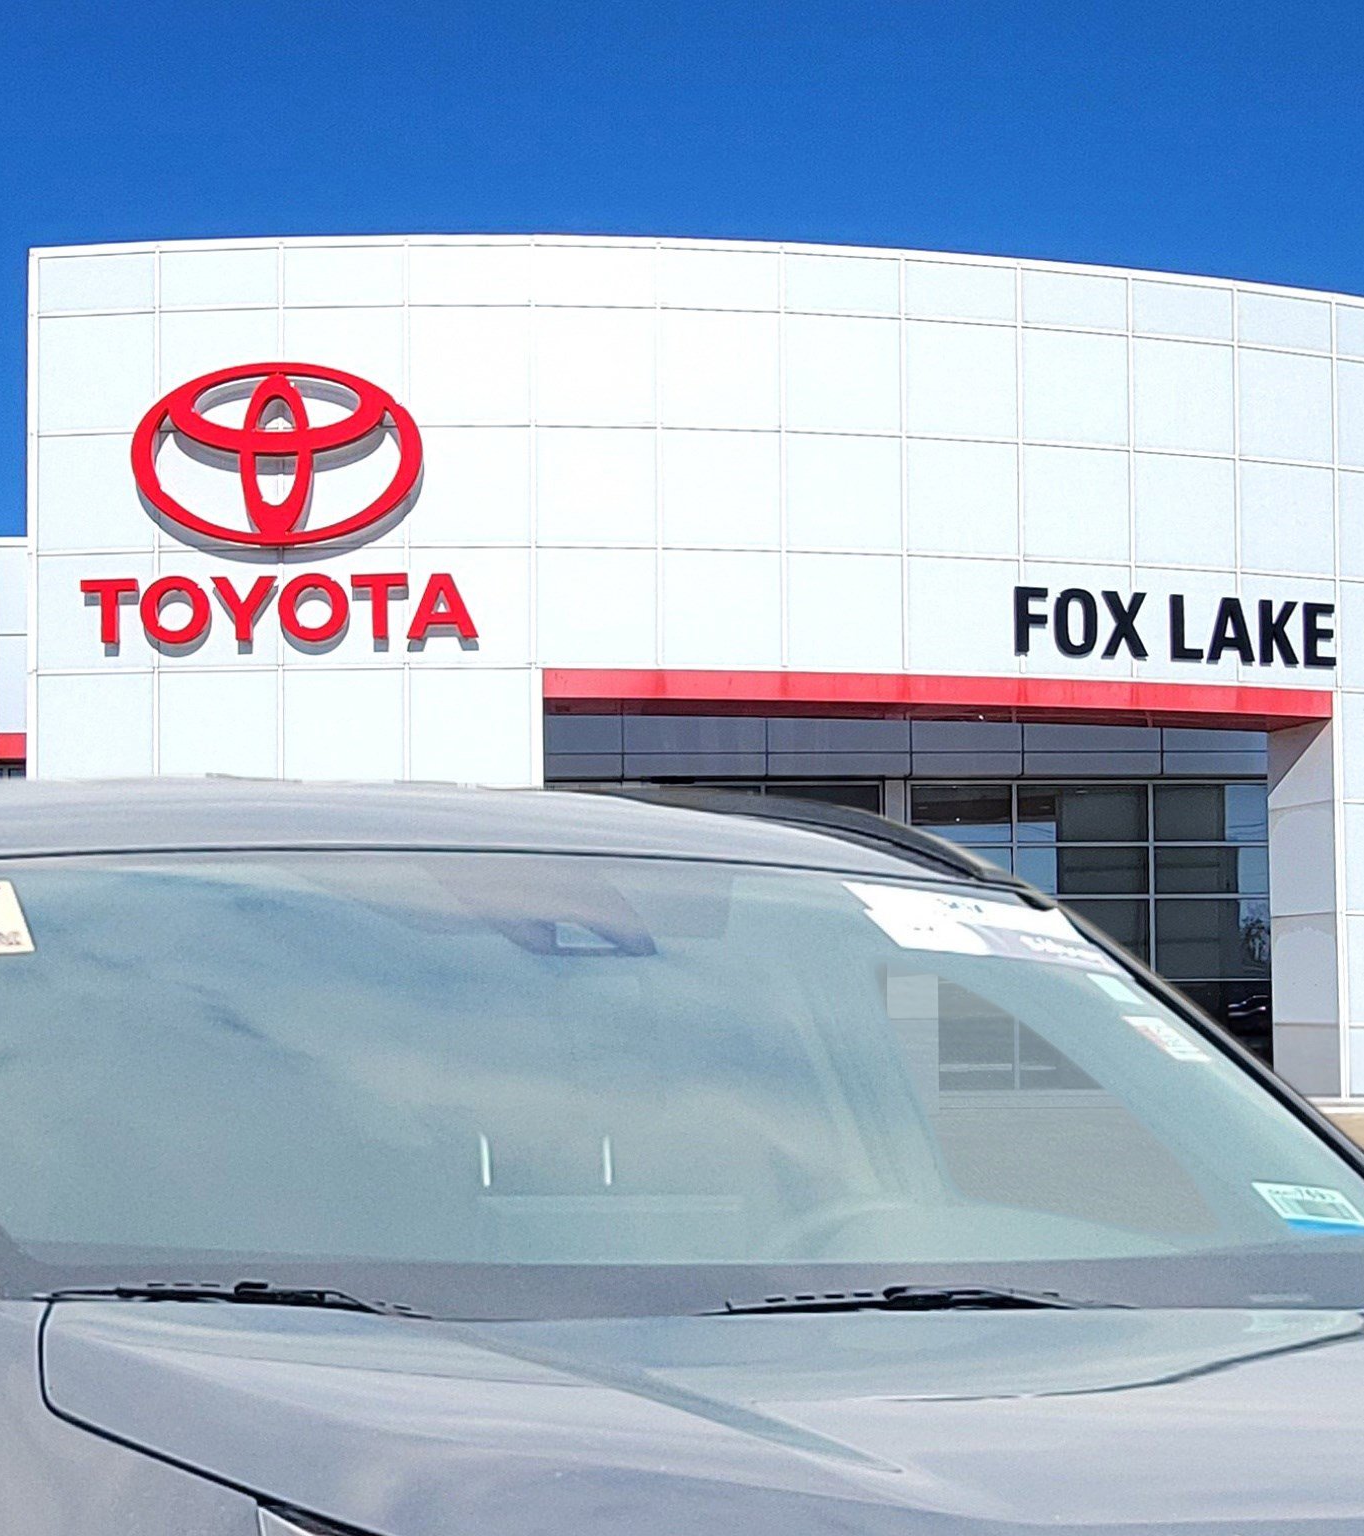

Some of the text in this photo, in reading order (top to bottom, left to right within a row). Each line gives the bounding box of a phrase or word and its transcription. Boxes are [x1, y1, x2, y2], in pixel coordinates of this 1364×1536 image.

[81, 572, 481, 650] TOYOTA
[1014, 586, 1337, 668] FOX LAKE
